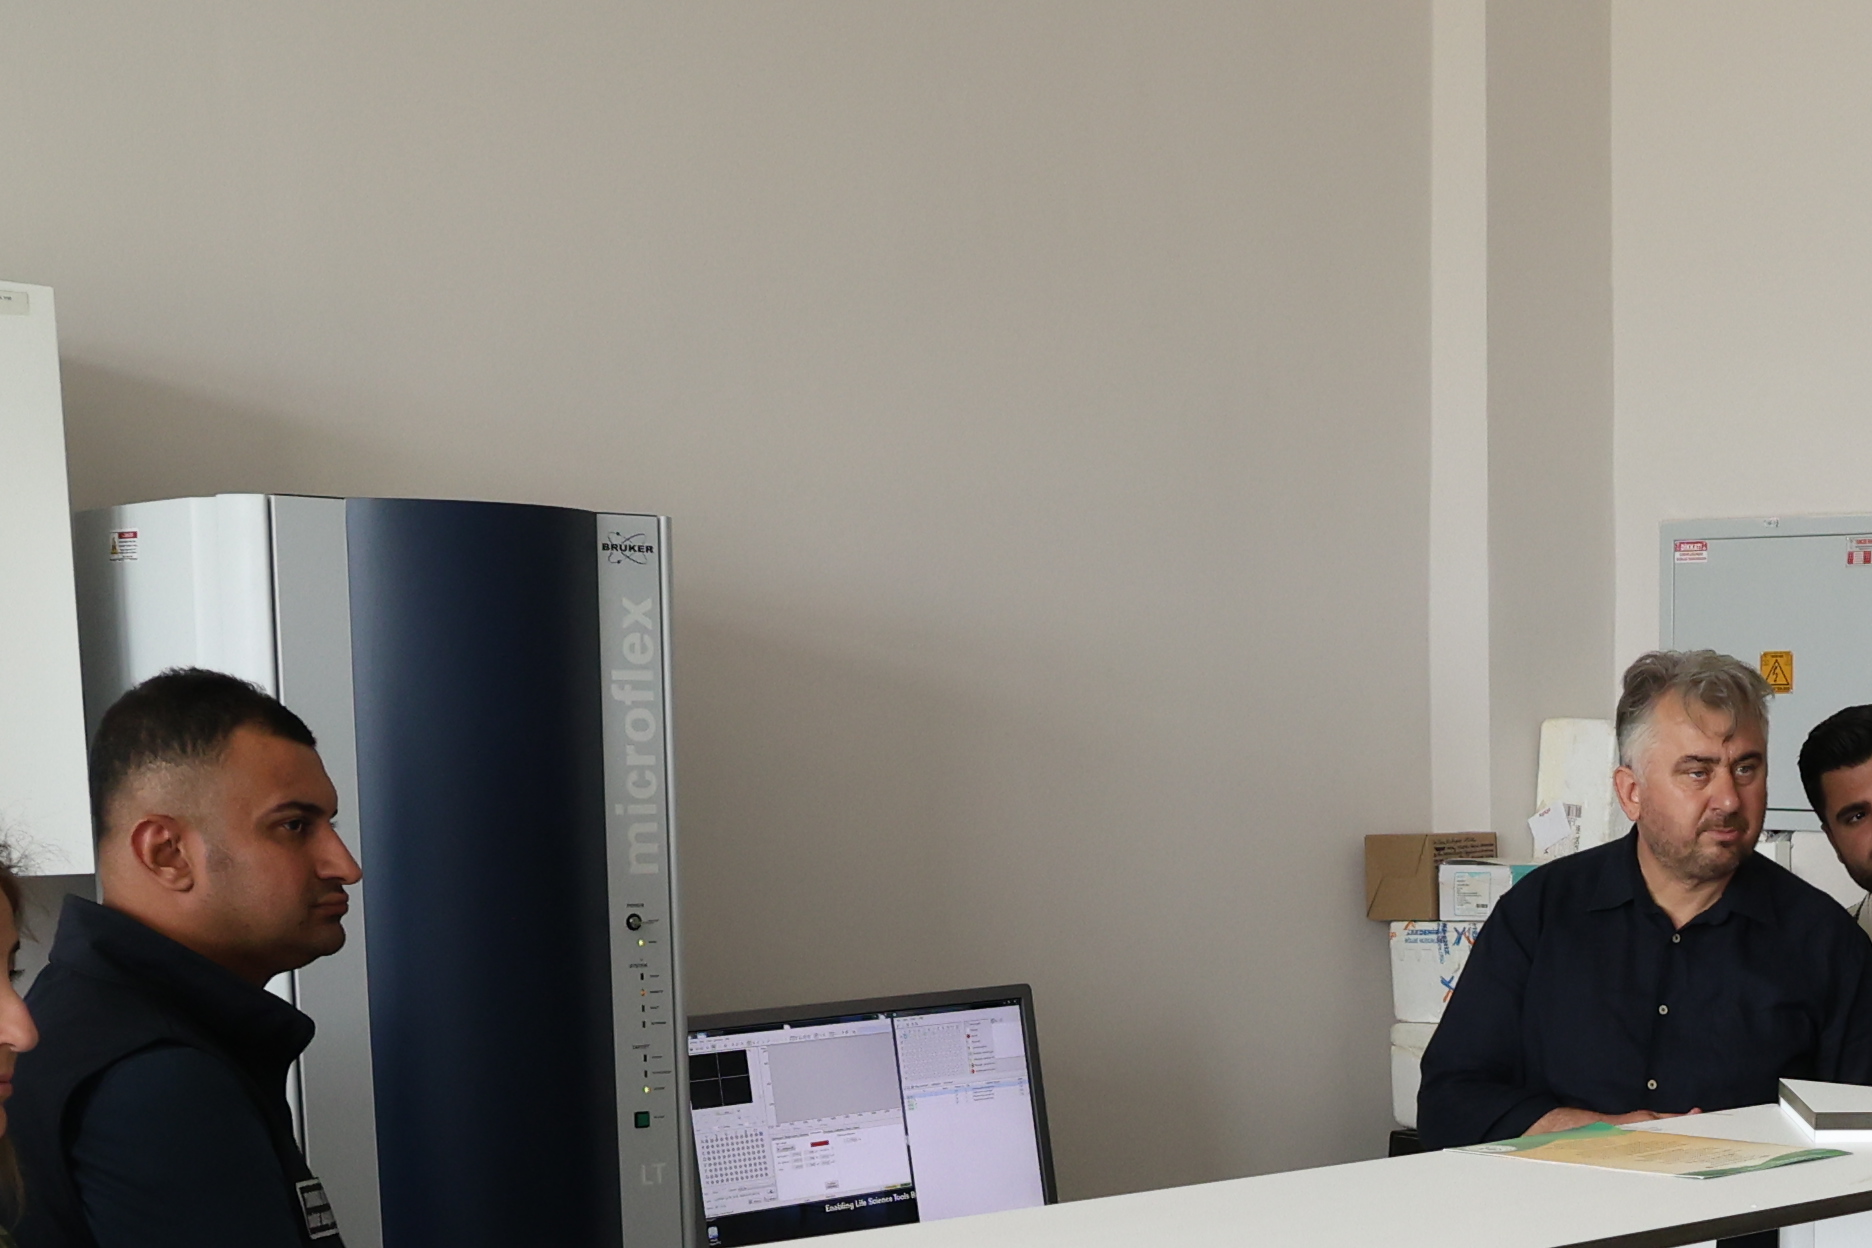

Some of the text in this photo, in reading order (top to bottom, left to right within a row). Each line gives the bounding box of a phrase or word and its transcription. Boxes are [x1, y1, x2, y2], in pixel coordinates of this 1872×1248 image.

[602, 542, 654, 554] BRUKER
[611, 597, 658, 875] microflex
[641, 1162, 667, 1186] LT
[825, 1202, 855, 1213] Enabling
[868, 1196, 893, 1206] Science
[893, 1193, 910, 1202] Tools
